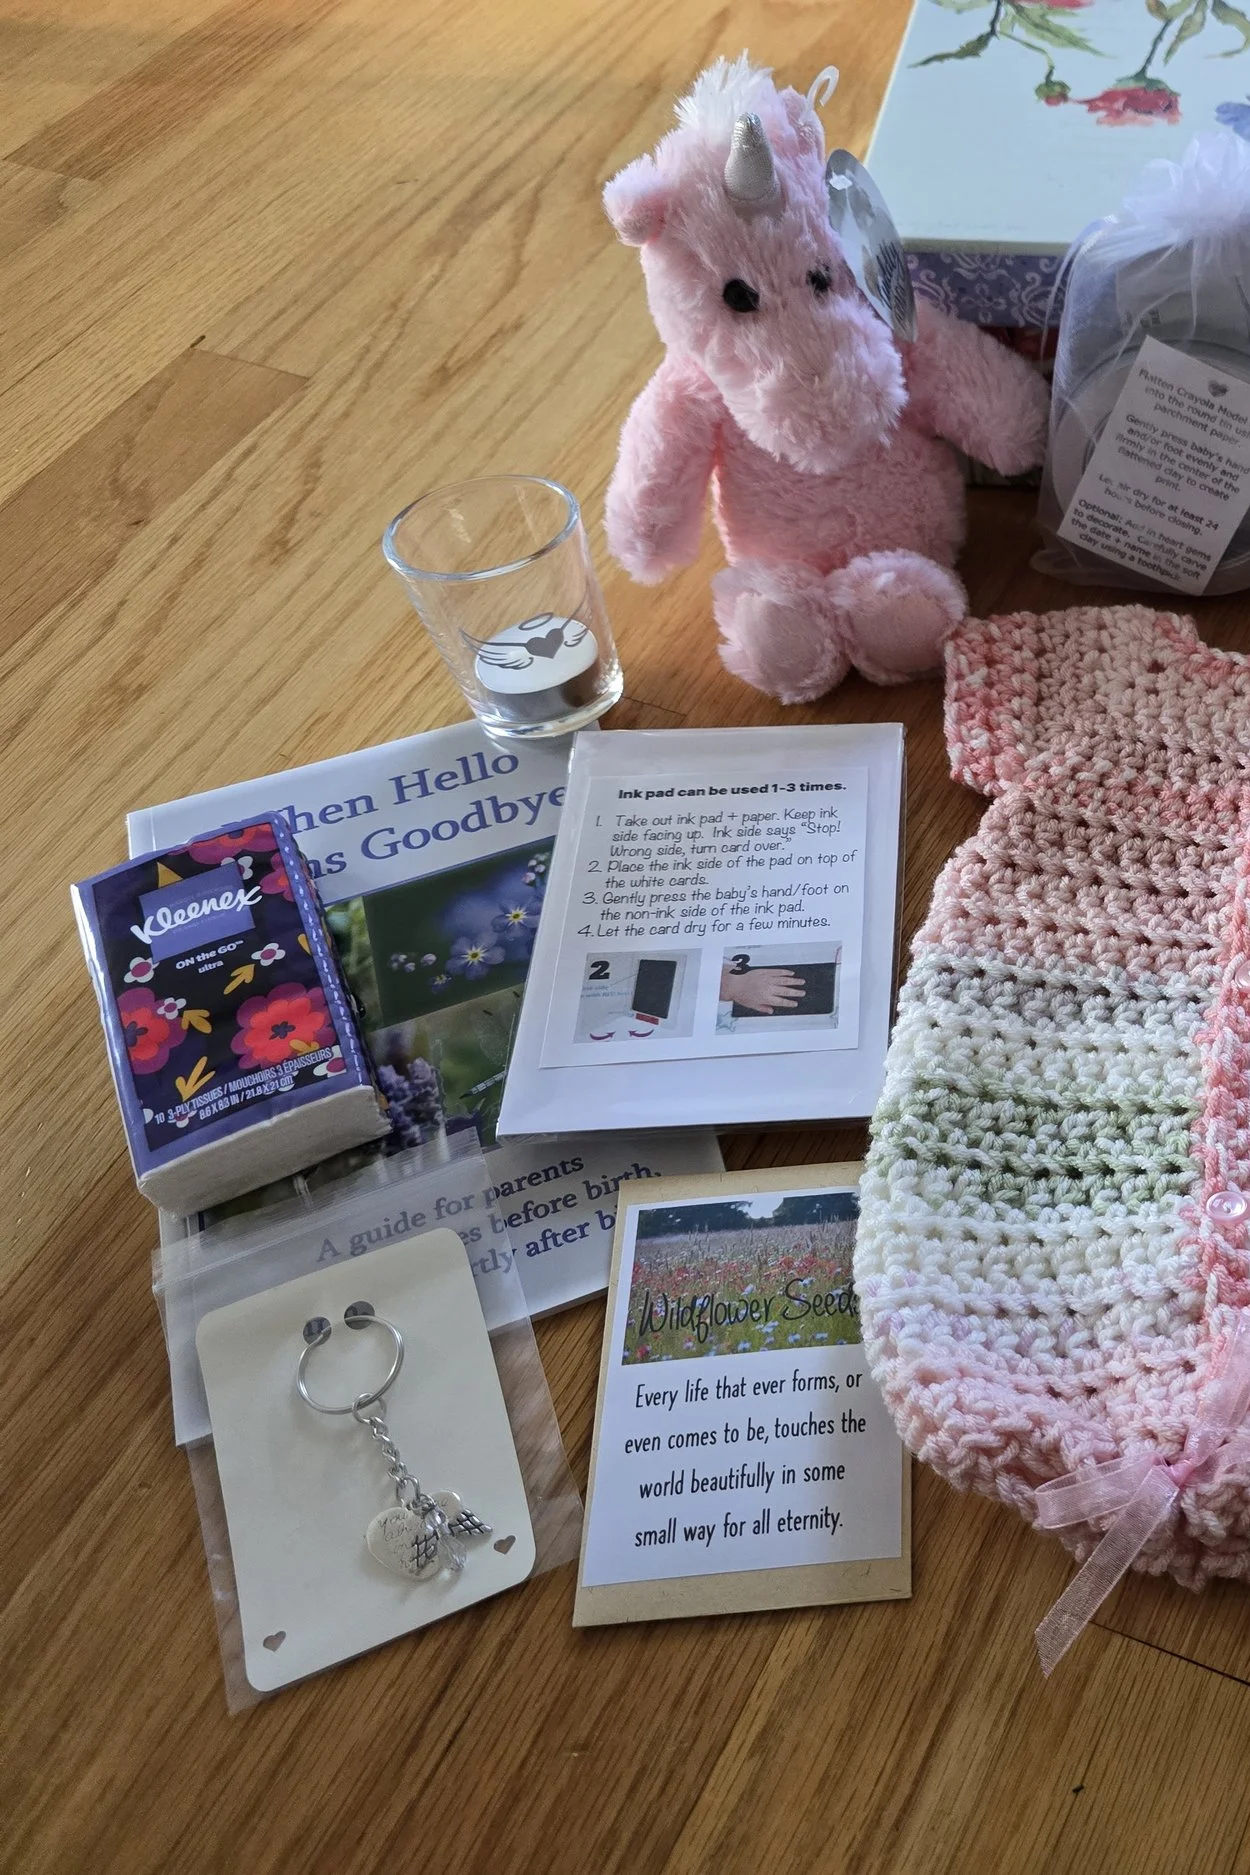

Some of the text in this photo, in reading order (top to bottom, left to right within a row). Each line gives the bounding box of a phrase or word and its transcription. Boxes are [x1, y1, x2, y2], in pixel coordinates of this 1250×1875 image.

[1153, 402, 1209, 432] parchment
[1176, 387, 1215, 410] Crayola
[1217, 404, 1248, 425] Model
[1125, 413, 1250, 474] Gently press baby's hand
[1163, 441, 1184, 457] foot
[1185, 453, 1219, 473] evenly
[1219, 468, 1240, 481] and
[1133, 498, 1166, 519] before
[1167, 503, 1219, 531] at least 24
[283, 752, 519, 835] hen Hello
[618, 781, 847, 801] Ink pad can be used 1-3 times.
[361, 786, 566, 861] Goodbye
[615, 814, 648, 827] Take
[651, 814, 673, 826] out
[676, 812, 696, 825] ink
[698, 810, 724, 826] pad
[727, 812, 739, 821] +
[741, 812, 780, 825] paper.
[783, 808, 816, 822] Keep
[819, 805, 838, 818] ink
[609, 844, 653, 859] Wrong
[656, 843, 686, 857] side,
[689, 843, 717, 854] turn
[720, 839, 751, 853] card
[611, 829, 639, 842] side
[642, 828, 683, 843] facing
[686, 830, 704, 842] up.
[712, 825, 733, 838] Ink
[736, 824, 762, 837] side
[765, 826, 796, 839] says
[606, 859, 645, 873] Place
[647, 858, 669, 872] the
[672, 857, 692, 871] ink
[696, 856, 723, 870] side
[726, 854, 742, 869] of
[745, 854, 765, 867] the
[768, 852, 793, 870] pad
[796, 855, 813, 865] on
[817, 853, 838, 867] top
[841, 848, 858, 862] of
[581, 882, 849, 907] 3. Gently press the baby's hand/foot on
[604, 872, 709, 889] the white cards.
[130, 886, 261, 944] Kleenex
[577, 916, 831, 937] 4. Let the card dry for a few minutes.
[600, 899, 805, 921] the non-ink side of the ink pad.
[175, 957, 195, 970] ON
[196, 950, 217, 962] the
[198, 960, 224, 974] ultra
[589, 960, 610, 980] 2
[729, 954, 751, 975] 3
[154, 1112, 165, 1125] 10
[167, 1104, 190, 1120] 3-PLY
[192, 1087, 223, 1111] TISSUES
[228, 1069, 277, 1092] MOUCHOIRS
[277, 1066, 284, 1077] 3
[284, 1048, 332, 1074] ÉPAISSEURS
[199, 1107, 212, 1120] 8.6
[212, 1104, 218, 1114] X
[218, 1098, 230, 1111] 8.3
[230, 1094, 240, 1106] IN
[246, 1087, 263, 1100] 21.8
[263, 1085, 269, 1095] X
[269, 1080, 279, 1092] 21
[280, 1075, 294, 1087] cm
[315, 1157, 584, 1263] A guide for parents
[460, 1225, 482, 1245] es
[488, 1192, 578, 1235] before
[525, 1217, 590, 1258] after
[639, 1288, 774, 1343] Wildflower
[635, 1368, 863, 1412] Every life that ever forms, or
[624, 1408, 866, 1454] even comes to be, touches the
[639, 1461, 845, 1499] world beautifully in some
[634, 1505, 843, 1548] small way for all eternity.
